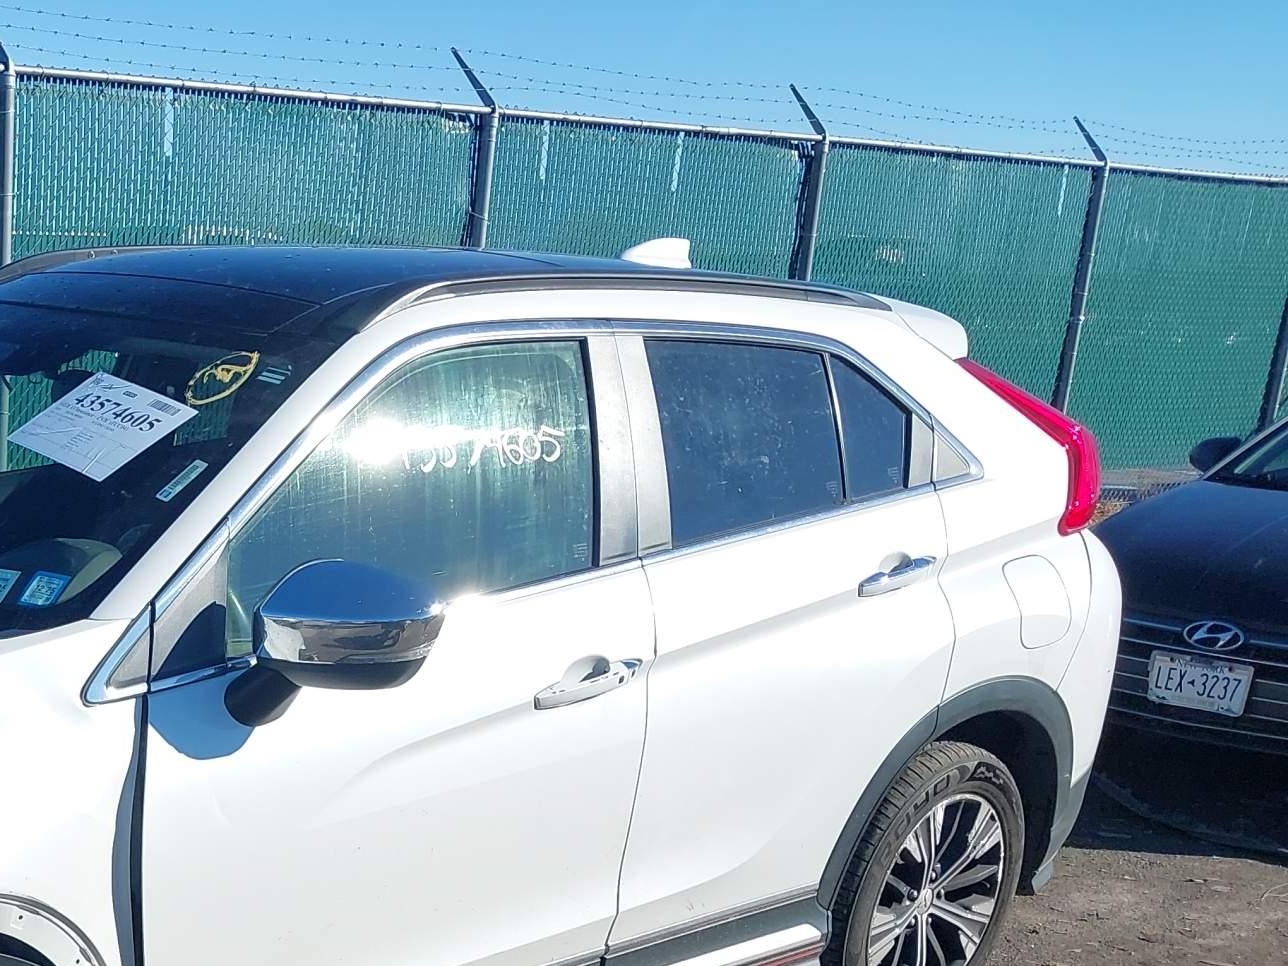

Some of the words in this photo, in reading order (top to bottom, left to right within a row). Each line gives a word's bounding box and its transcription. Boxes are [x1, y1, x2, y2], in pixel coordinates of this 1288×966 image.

[74, 392, 163, 432] 43574605
[401, 424, 565, 473] 74605
[1154, 665, 1188, 694] LEX
[1196, 672, 1242, 702] 3237
